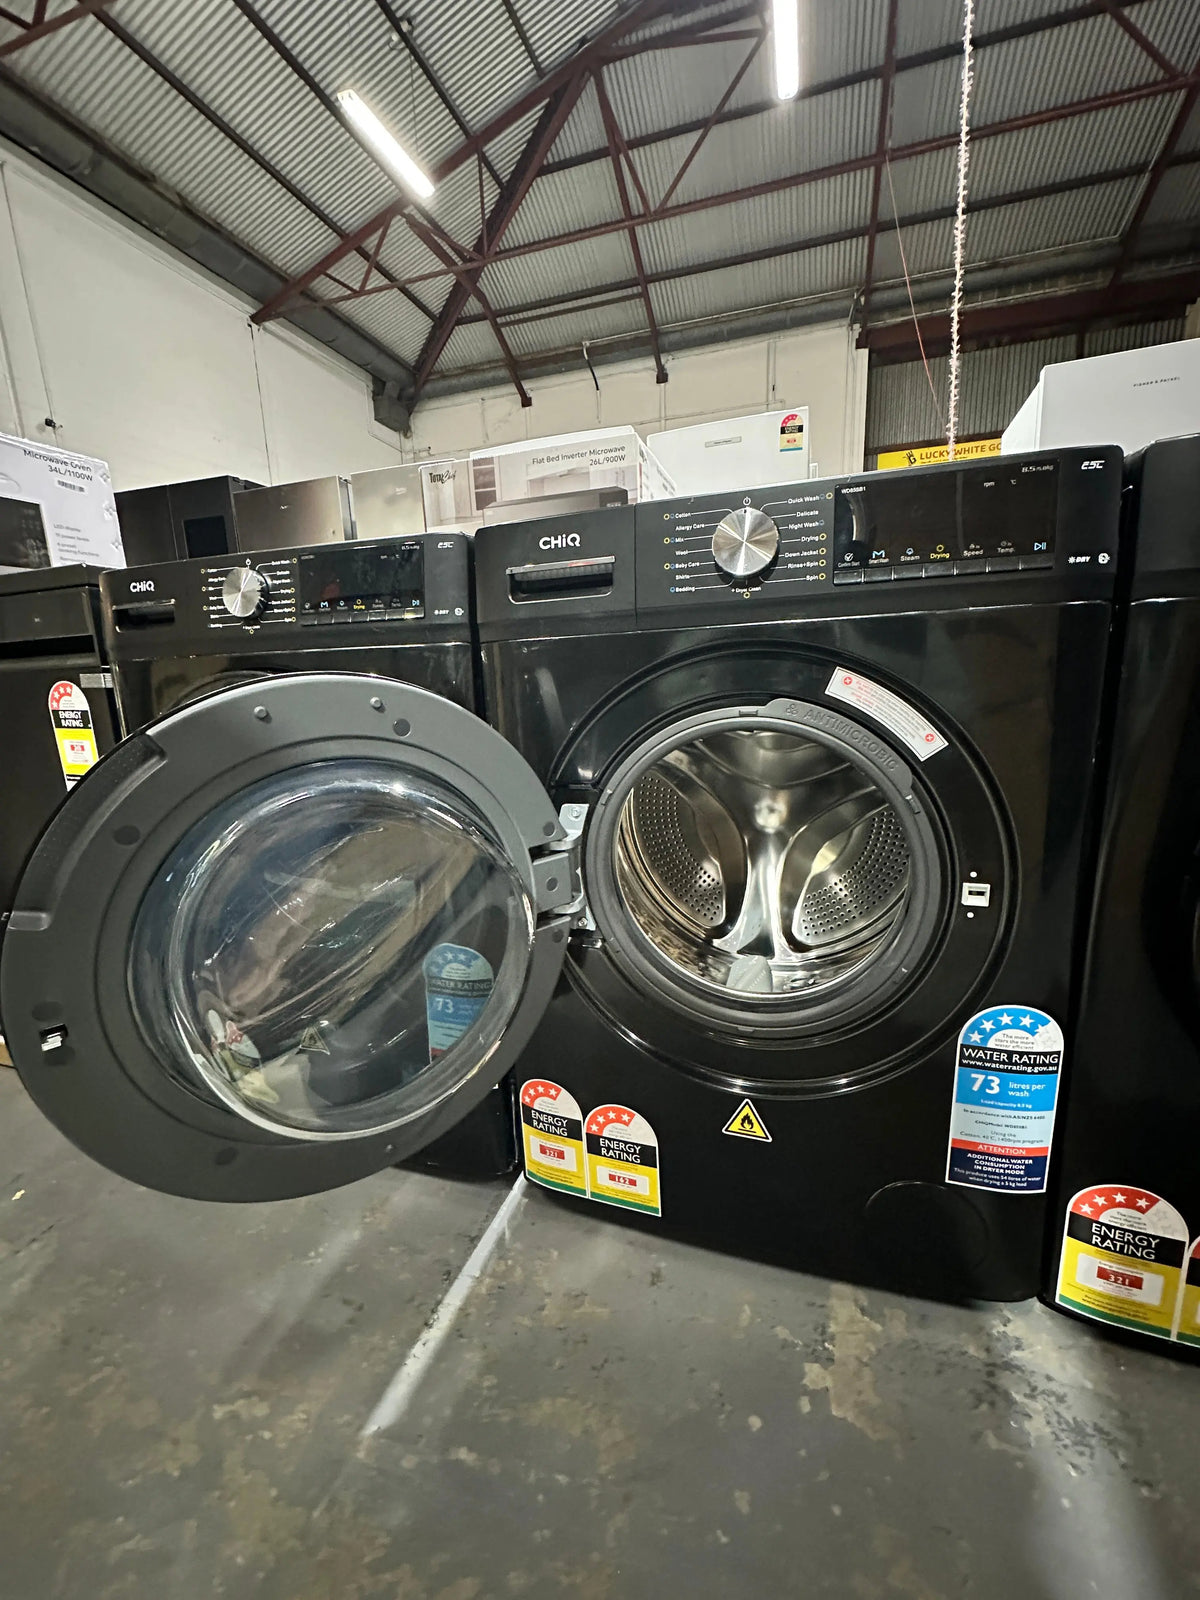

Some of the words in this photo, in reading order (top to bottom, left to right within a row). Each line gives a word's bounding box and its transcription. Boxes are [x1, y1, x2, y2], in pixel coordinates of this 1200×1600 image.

[532, 457, 544, 465] Flat
[546, 455, 560, 463] Bed
[561, 451, 587, 461] Inverter
[588, 445, 626, 457] Microwave
[953, 444, 986, 456] WHITE
[23, 449, 69, 467] Microwave
[70, 461, 92, 472] Oven
[589, 454, 626, 466] 26L/900W
[48, 464, 93, 481] 34L/1100W
[539, 533, 580, 550] CHiQ
[963, 549, 983, 557] Speed
[130, 580, 155, 592] CHiQ
[803, 709, 899, 771] ANTIMICROBIC
[435, 997, 454, 1014] 73
[963, 1047, 1009, 1062] WATER
[1012, 1054, 1059, 1064] RATING
[962, 1059, 1058, 1073] www.waterrating.gov.au
[970, 1073, 1000, 1094] 73
[1008, 1082, 1030, 1090] litres
[1031, 1084, 1046, 1092] per
[531, 1110, 568, 1127] ENERGY
[532, 1119, 568, 1136] RATING
[600, 1138, 641, 1154] ENERGY
[977, 1145, 1026, 1155] ATTENTION
[601, 1147, 641, 1164] RATING
[967, 1153, 1010, 1164] ADDITIONAL
[974, 1160, 1025, 1170] CONSUMPTION
[982, 1166, 1004, 1174] DRYER
[1091, 1222, 1160, 1248] ENERGY
[1091, 1234, 1156, 1260] RATING
[1108, 1274, 1129, 1286] 321
